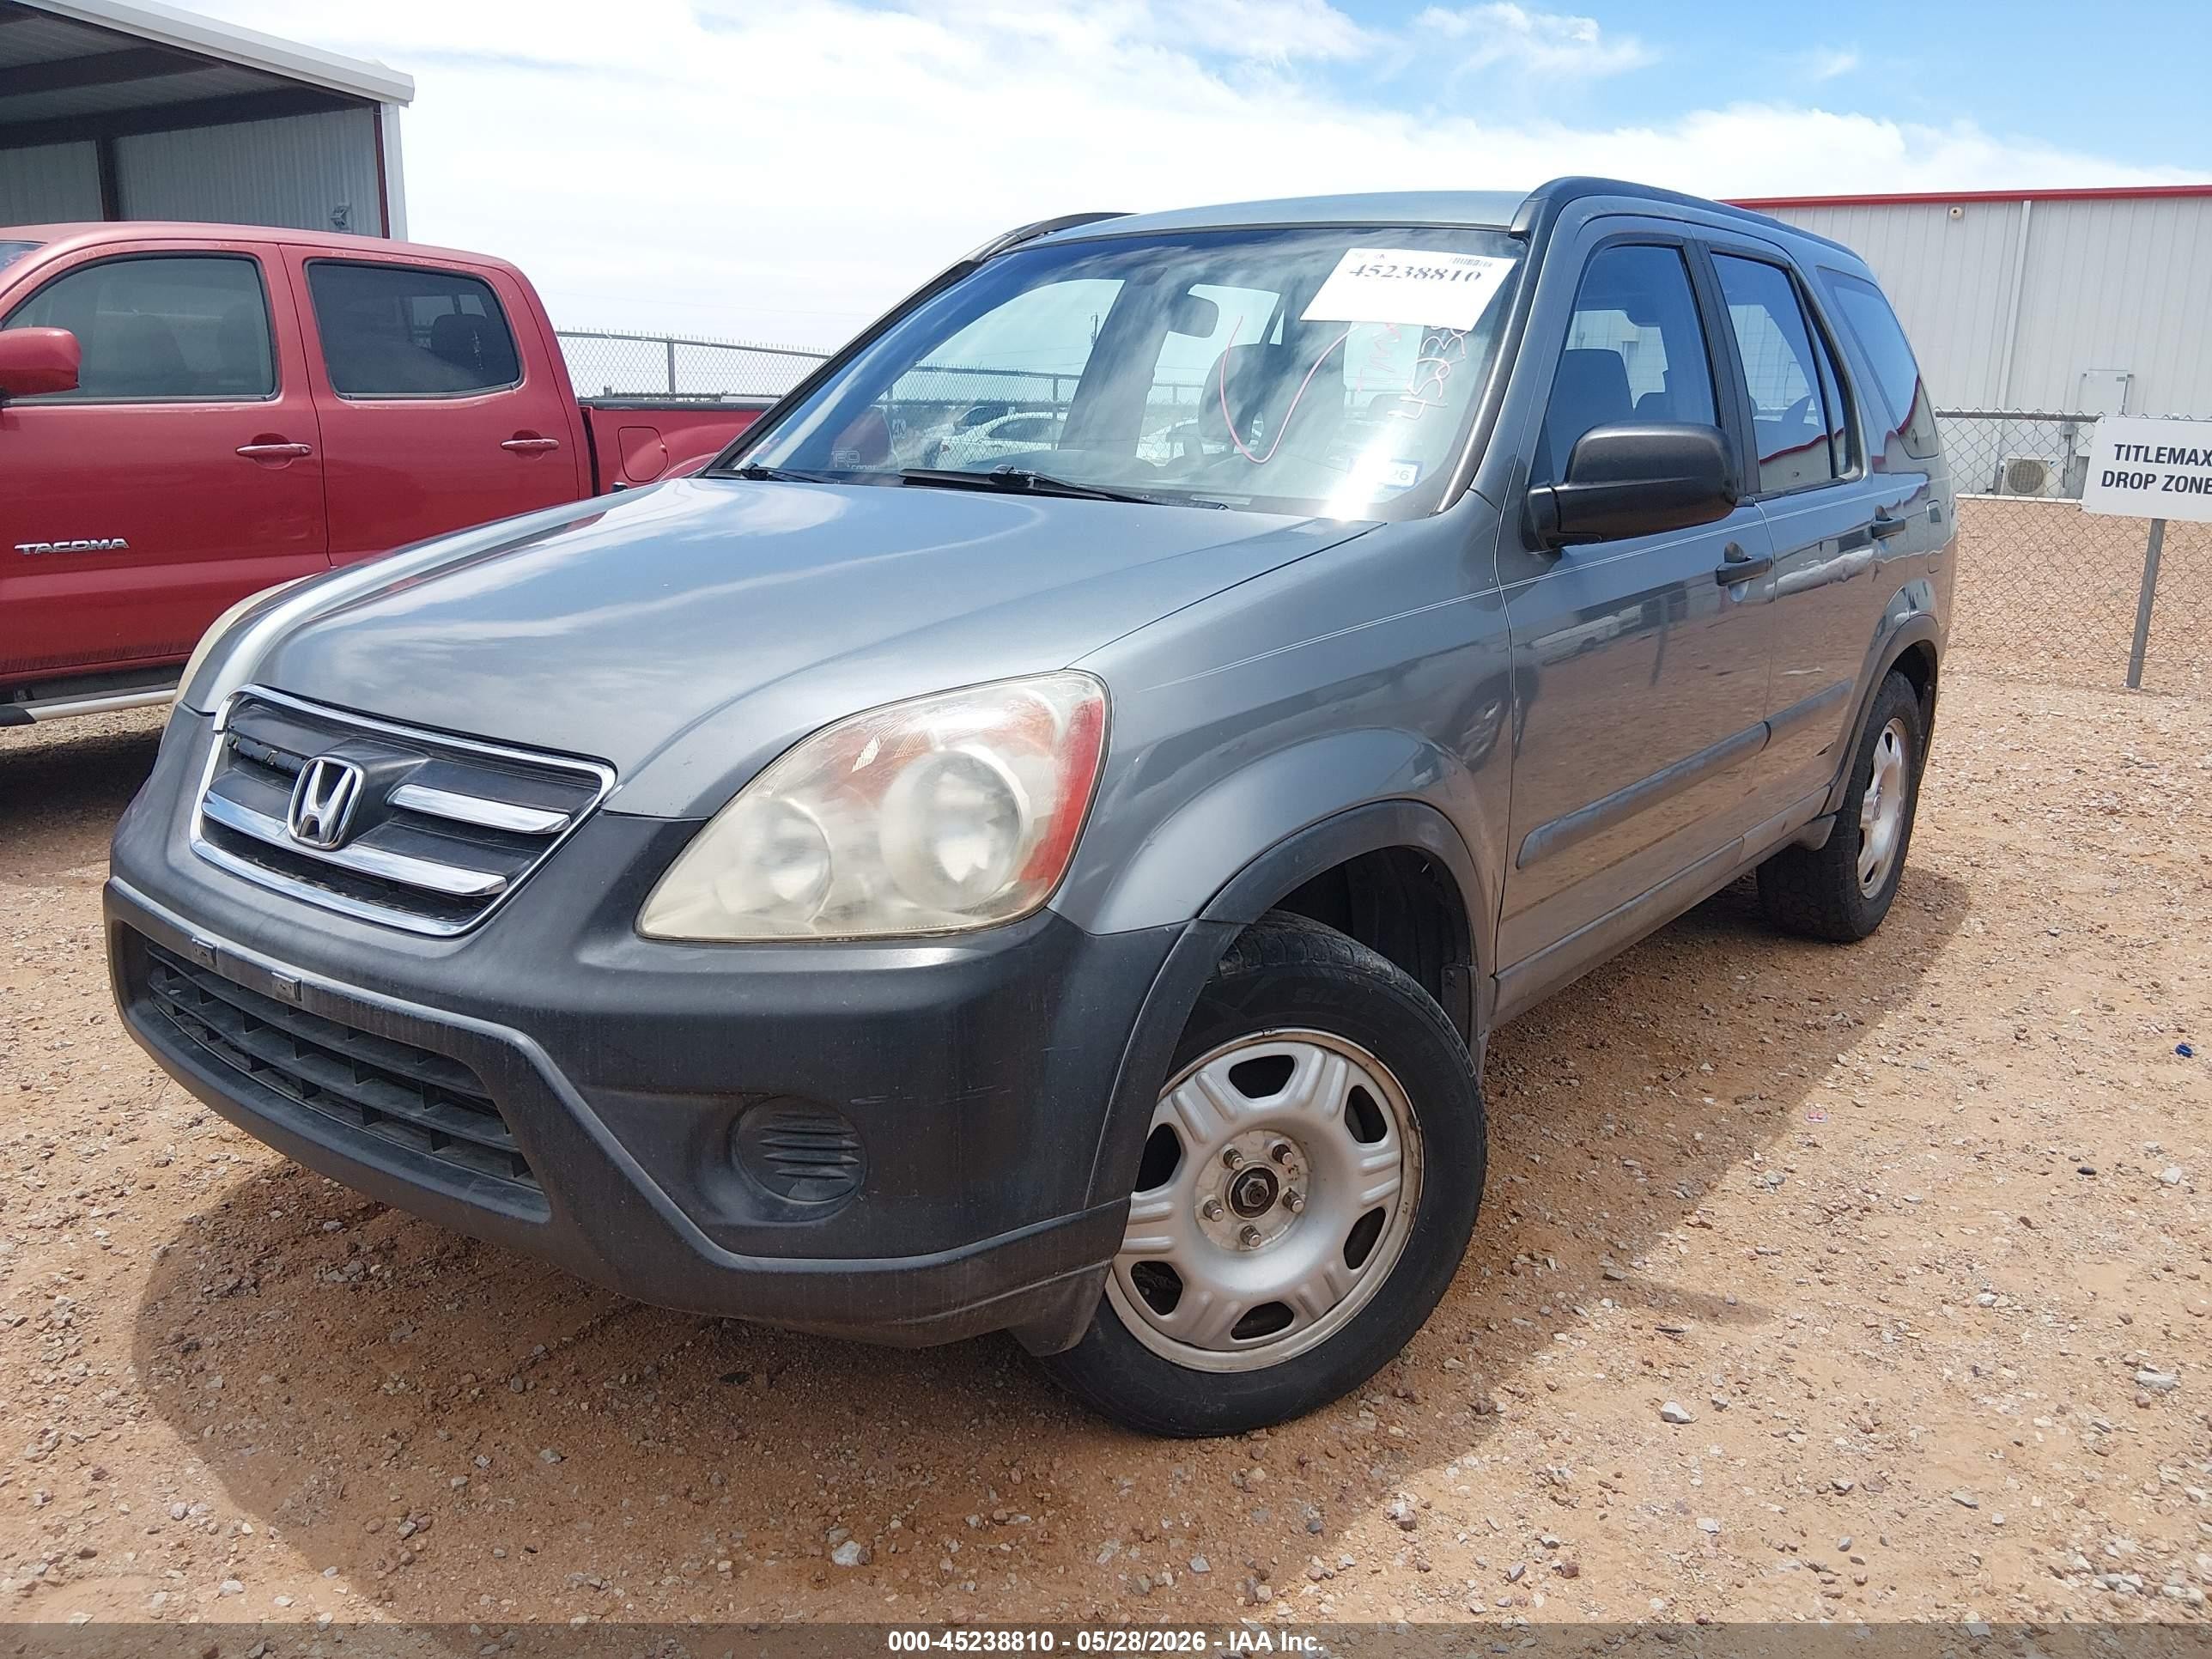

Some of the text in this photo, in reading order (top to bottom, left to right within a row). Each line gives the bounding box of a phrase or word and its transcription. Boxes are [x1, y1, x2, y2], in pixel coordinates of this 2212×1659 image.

[1349, 264, 1482, 283] 45238810
[2113, 443, 2212, 467] TITLEMAX
[2100, 470, 2212, 495] DROP ZONE
[14, 538, 131, 555] TACOMA
